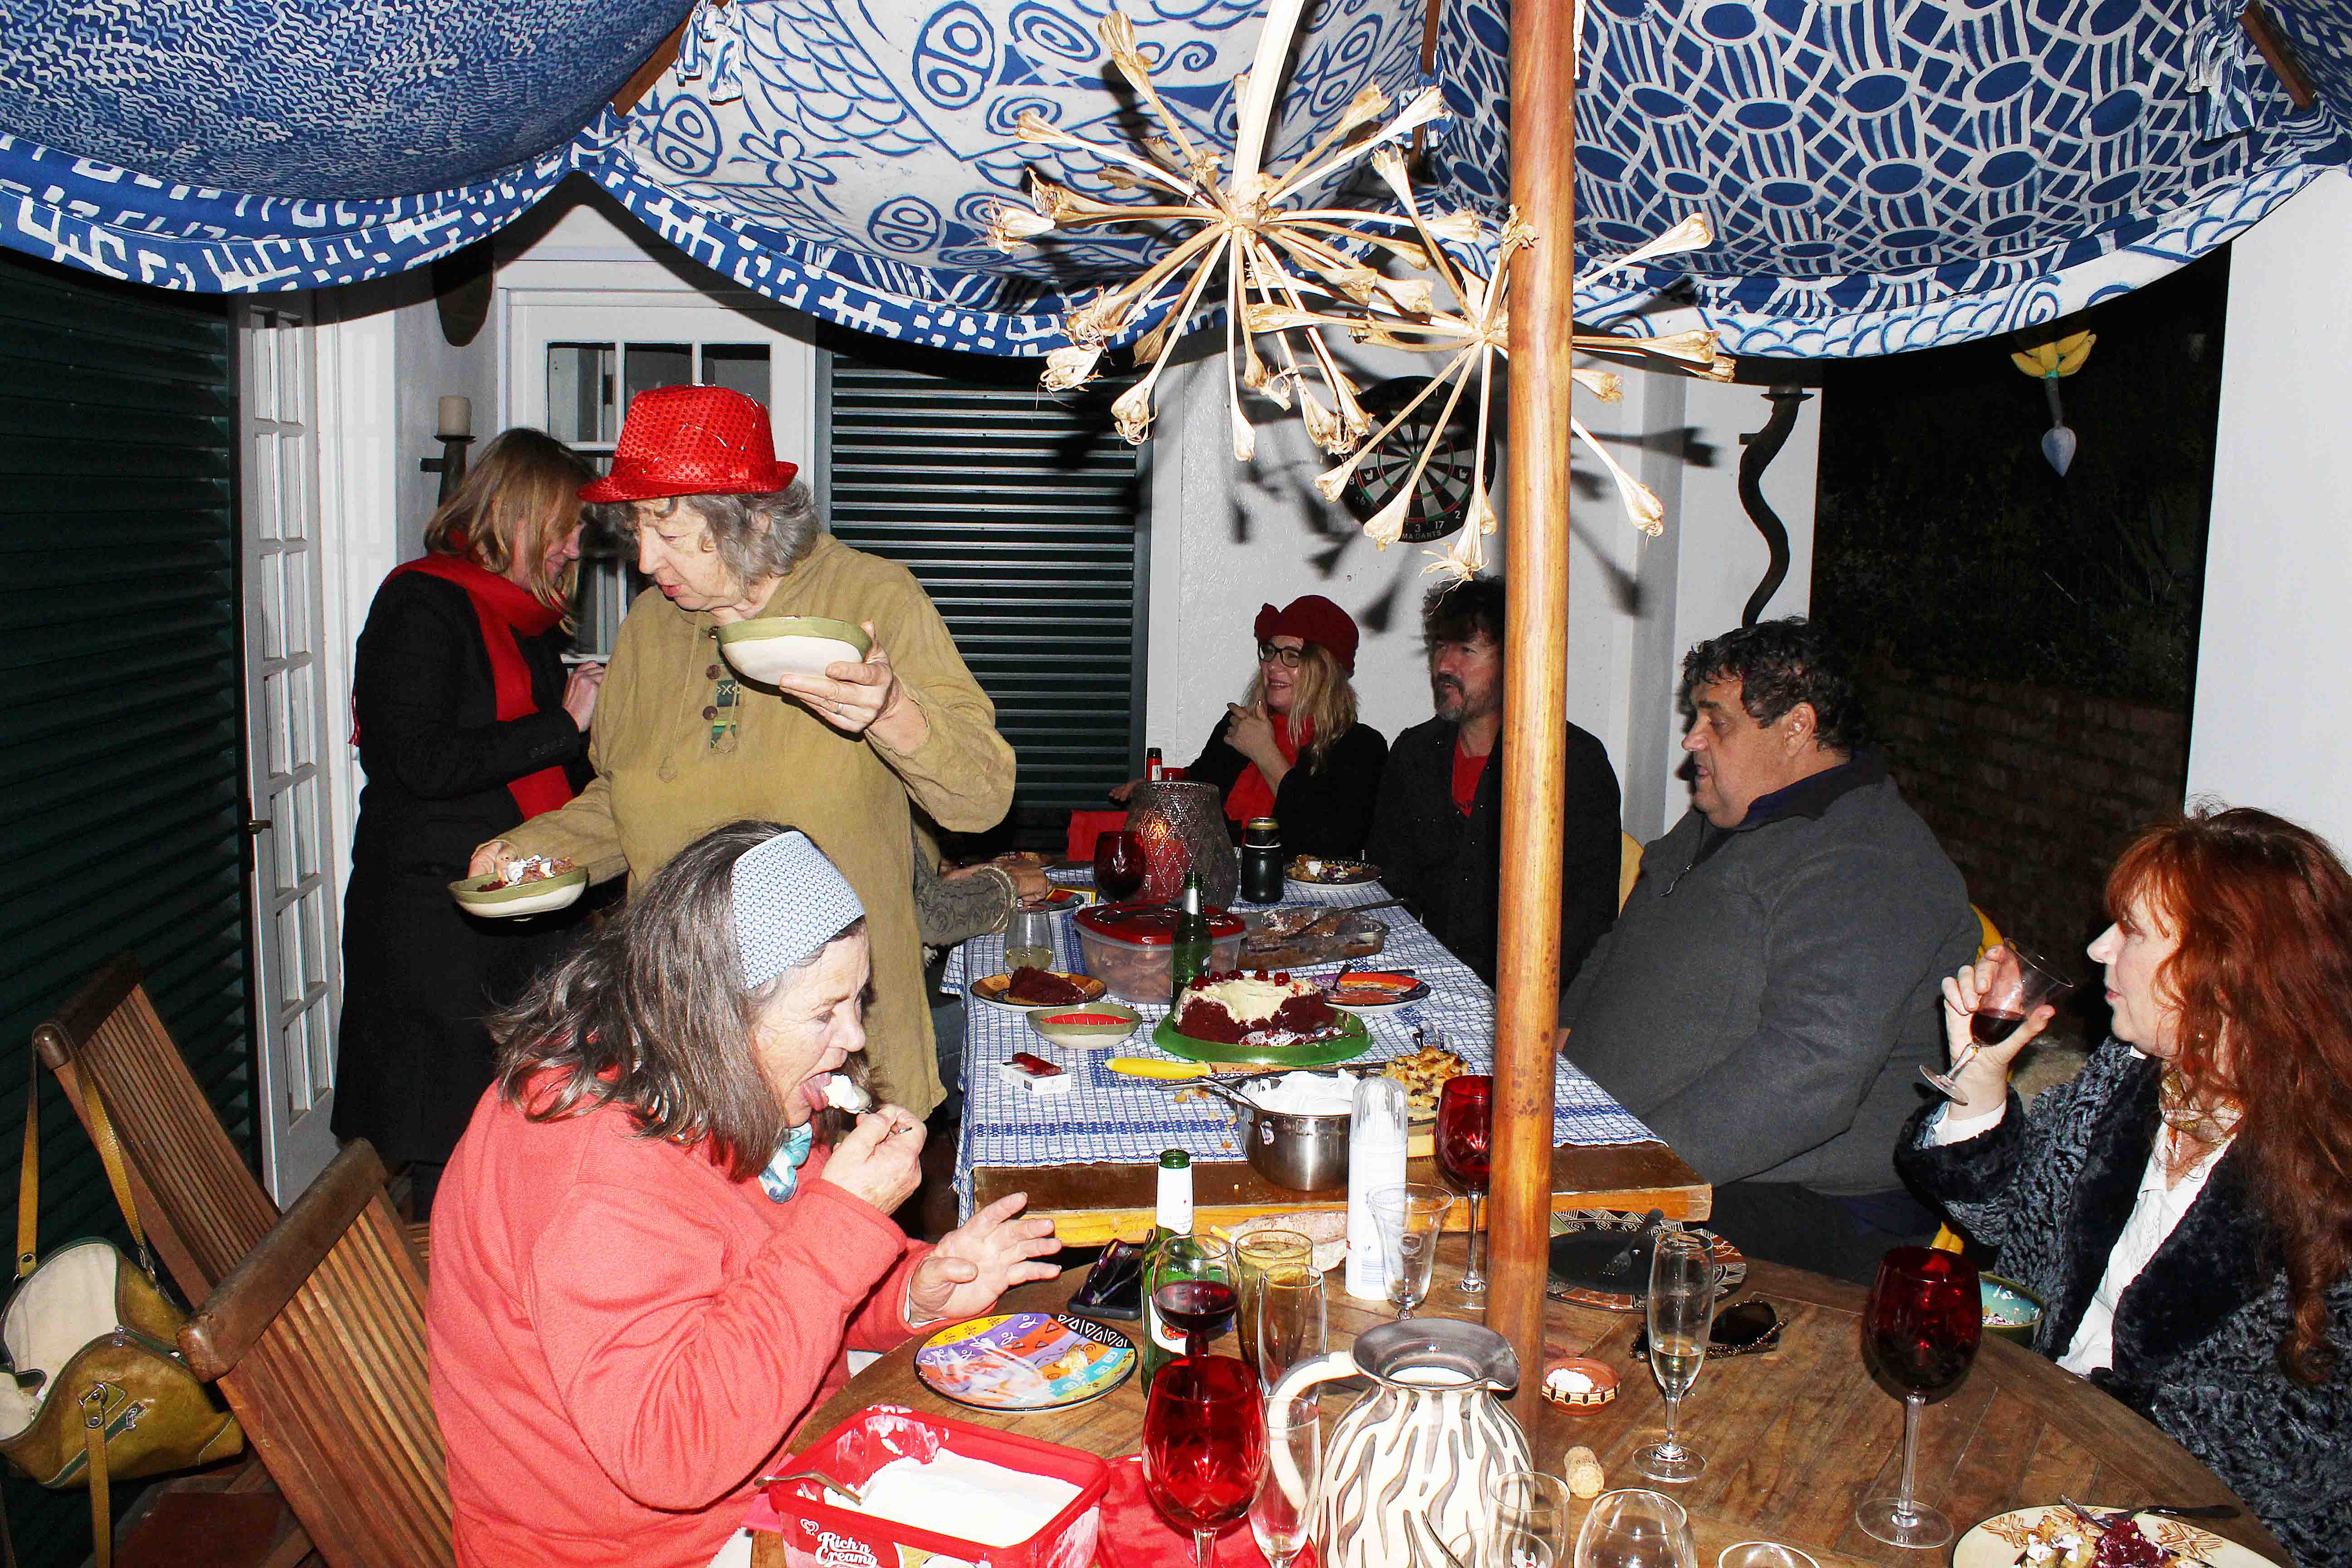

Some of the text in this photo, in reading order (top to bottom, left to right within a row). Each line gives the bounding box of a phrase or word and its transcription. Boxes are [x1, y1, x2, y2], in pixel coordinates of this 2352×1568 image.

[1349, 476, 1355, 485] 8
[1455, 510, 1460, 519] 2
[1415, 524, 1421, 533] 3
[1435, 521, 1445, 529] 17
[817, 1531, 871, 1553] Rich'n
[815, 1545, 878, 1568] Creamy
